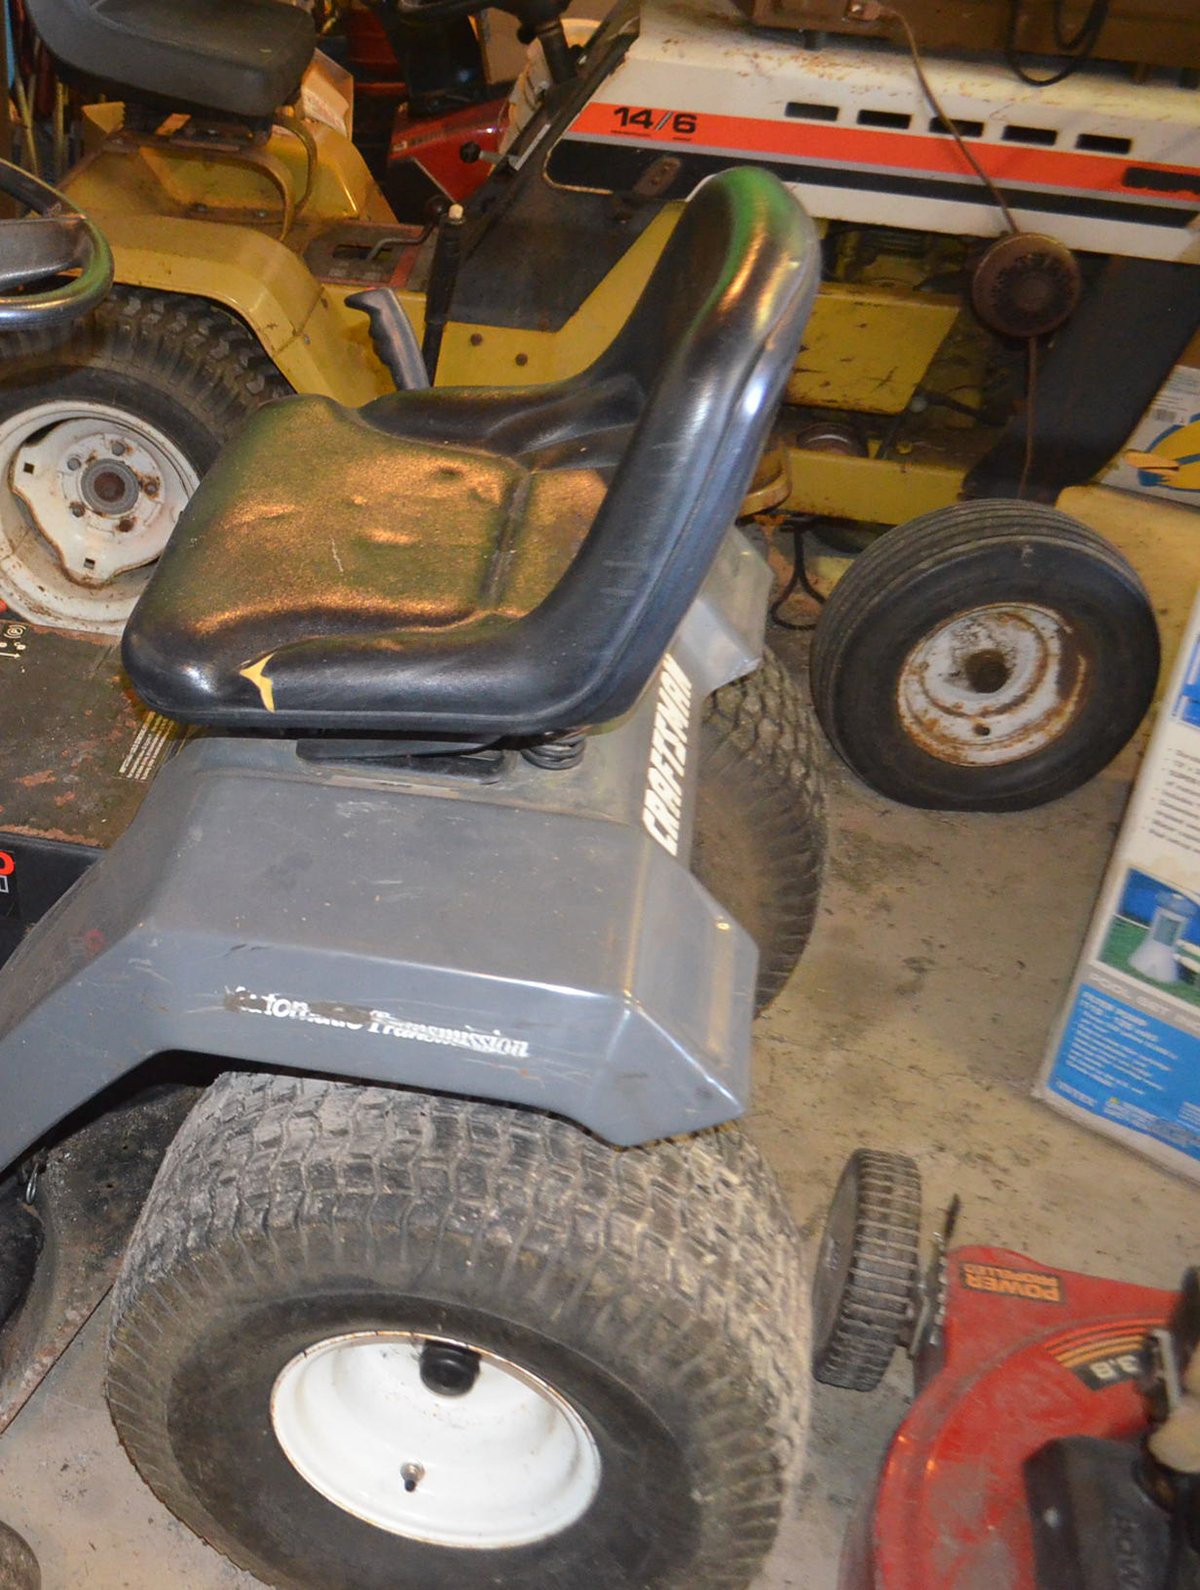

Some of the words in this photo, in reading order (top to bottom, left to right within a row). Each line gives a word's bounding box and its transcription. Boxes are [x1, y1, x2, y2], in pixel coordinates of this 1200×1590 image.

[614, 106, 697, 134] 14/6
[643, 652, 693, 858] CRAFTSMAN
[965, 1273, 1061, 1301] POWER
